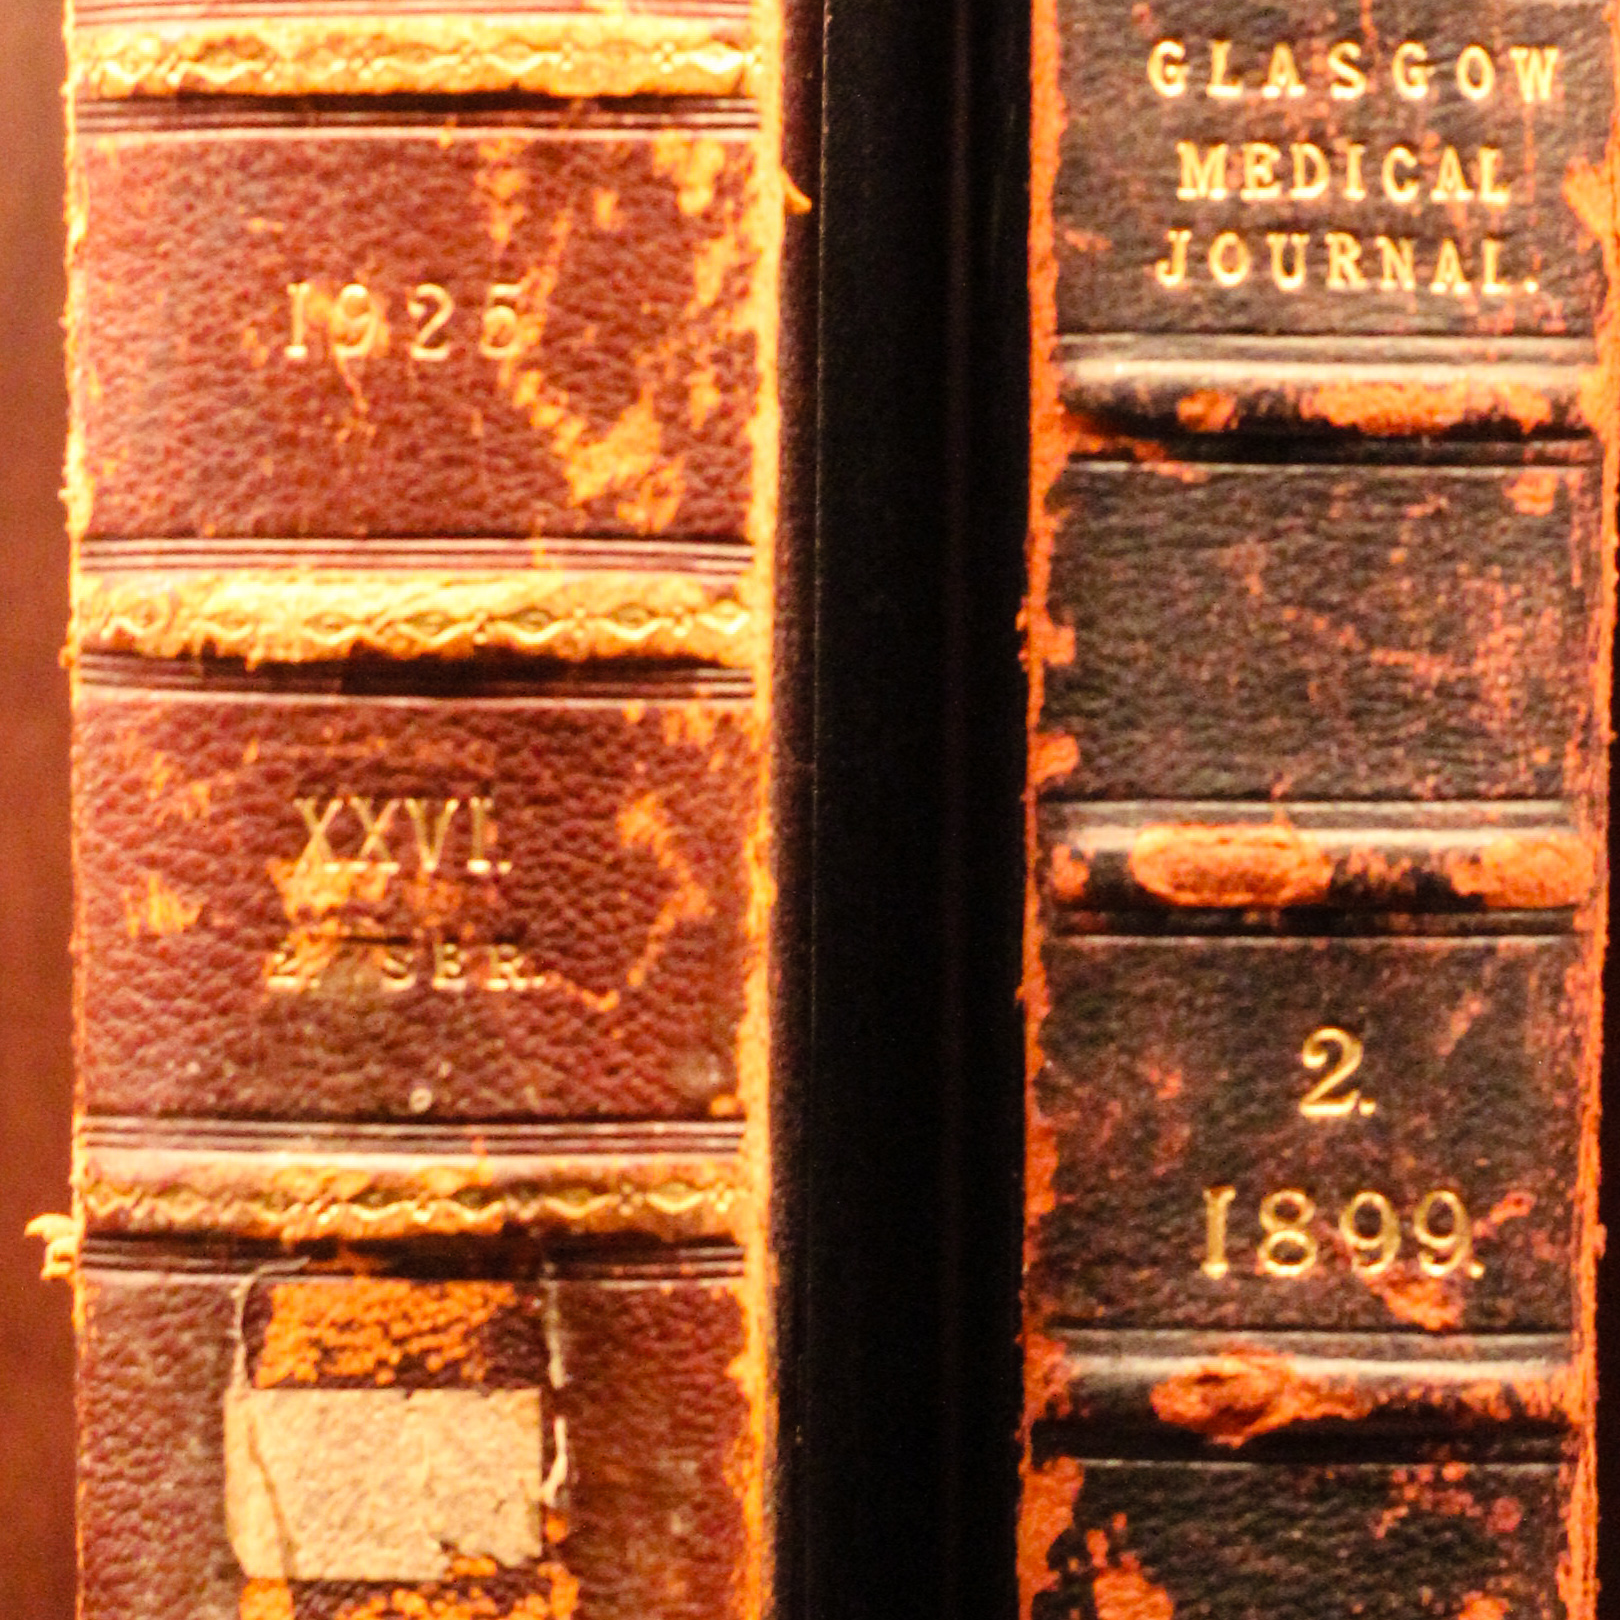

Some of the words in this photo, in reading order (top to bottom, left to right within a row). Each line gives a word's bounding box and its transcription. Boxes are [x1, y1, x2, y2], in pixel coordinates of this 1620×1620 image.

[1147, 38, 1560, 103] GLASGOW
[1176, 139, 1512, 204] MEDICAL
[1155, 229, 1540, 294] JOURNAL.
[284, 282, 524, 361] 1925
[293, 796, 513, 875] XXVI.
[1299, 1025, 1377, 1118] 2.
[1202, 1186, 1486, 1279] 1899.
